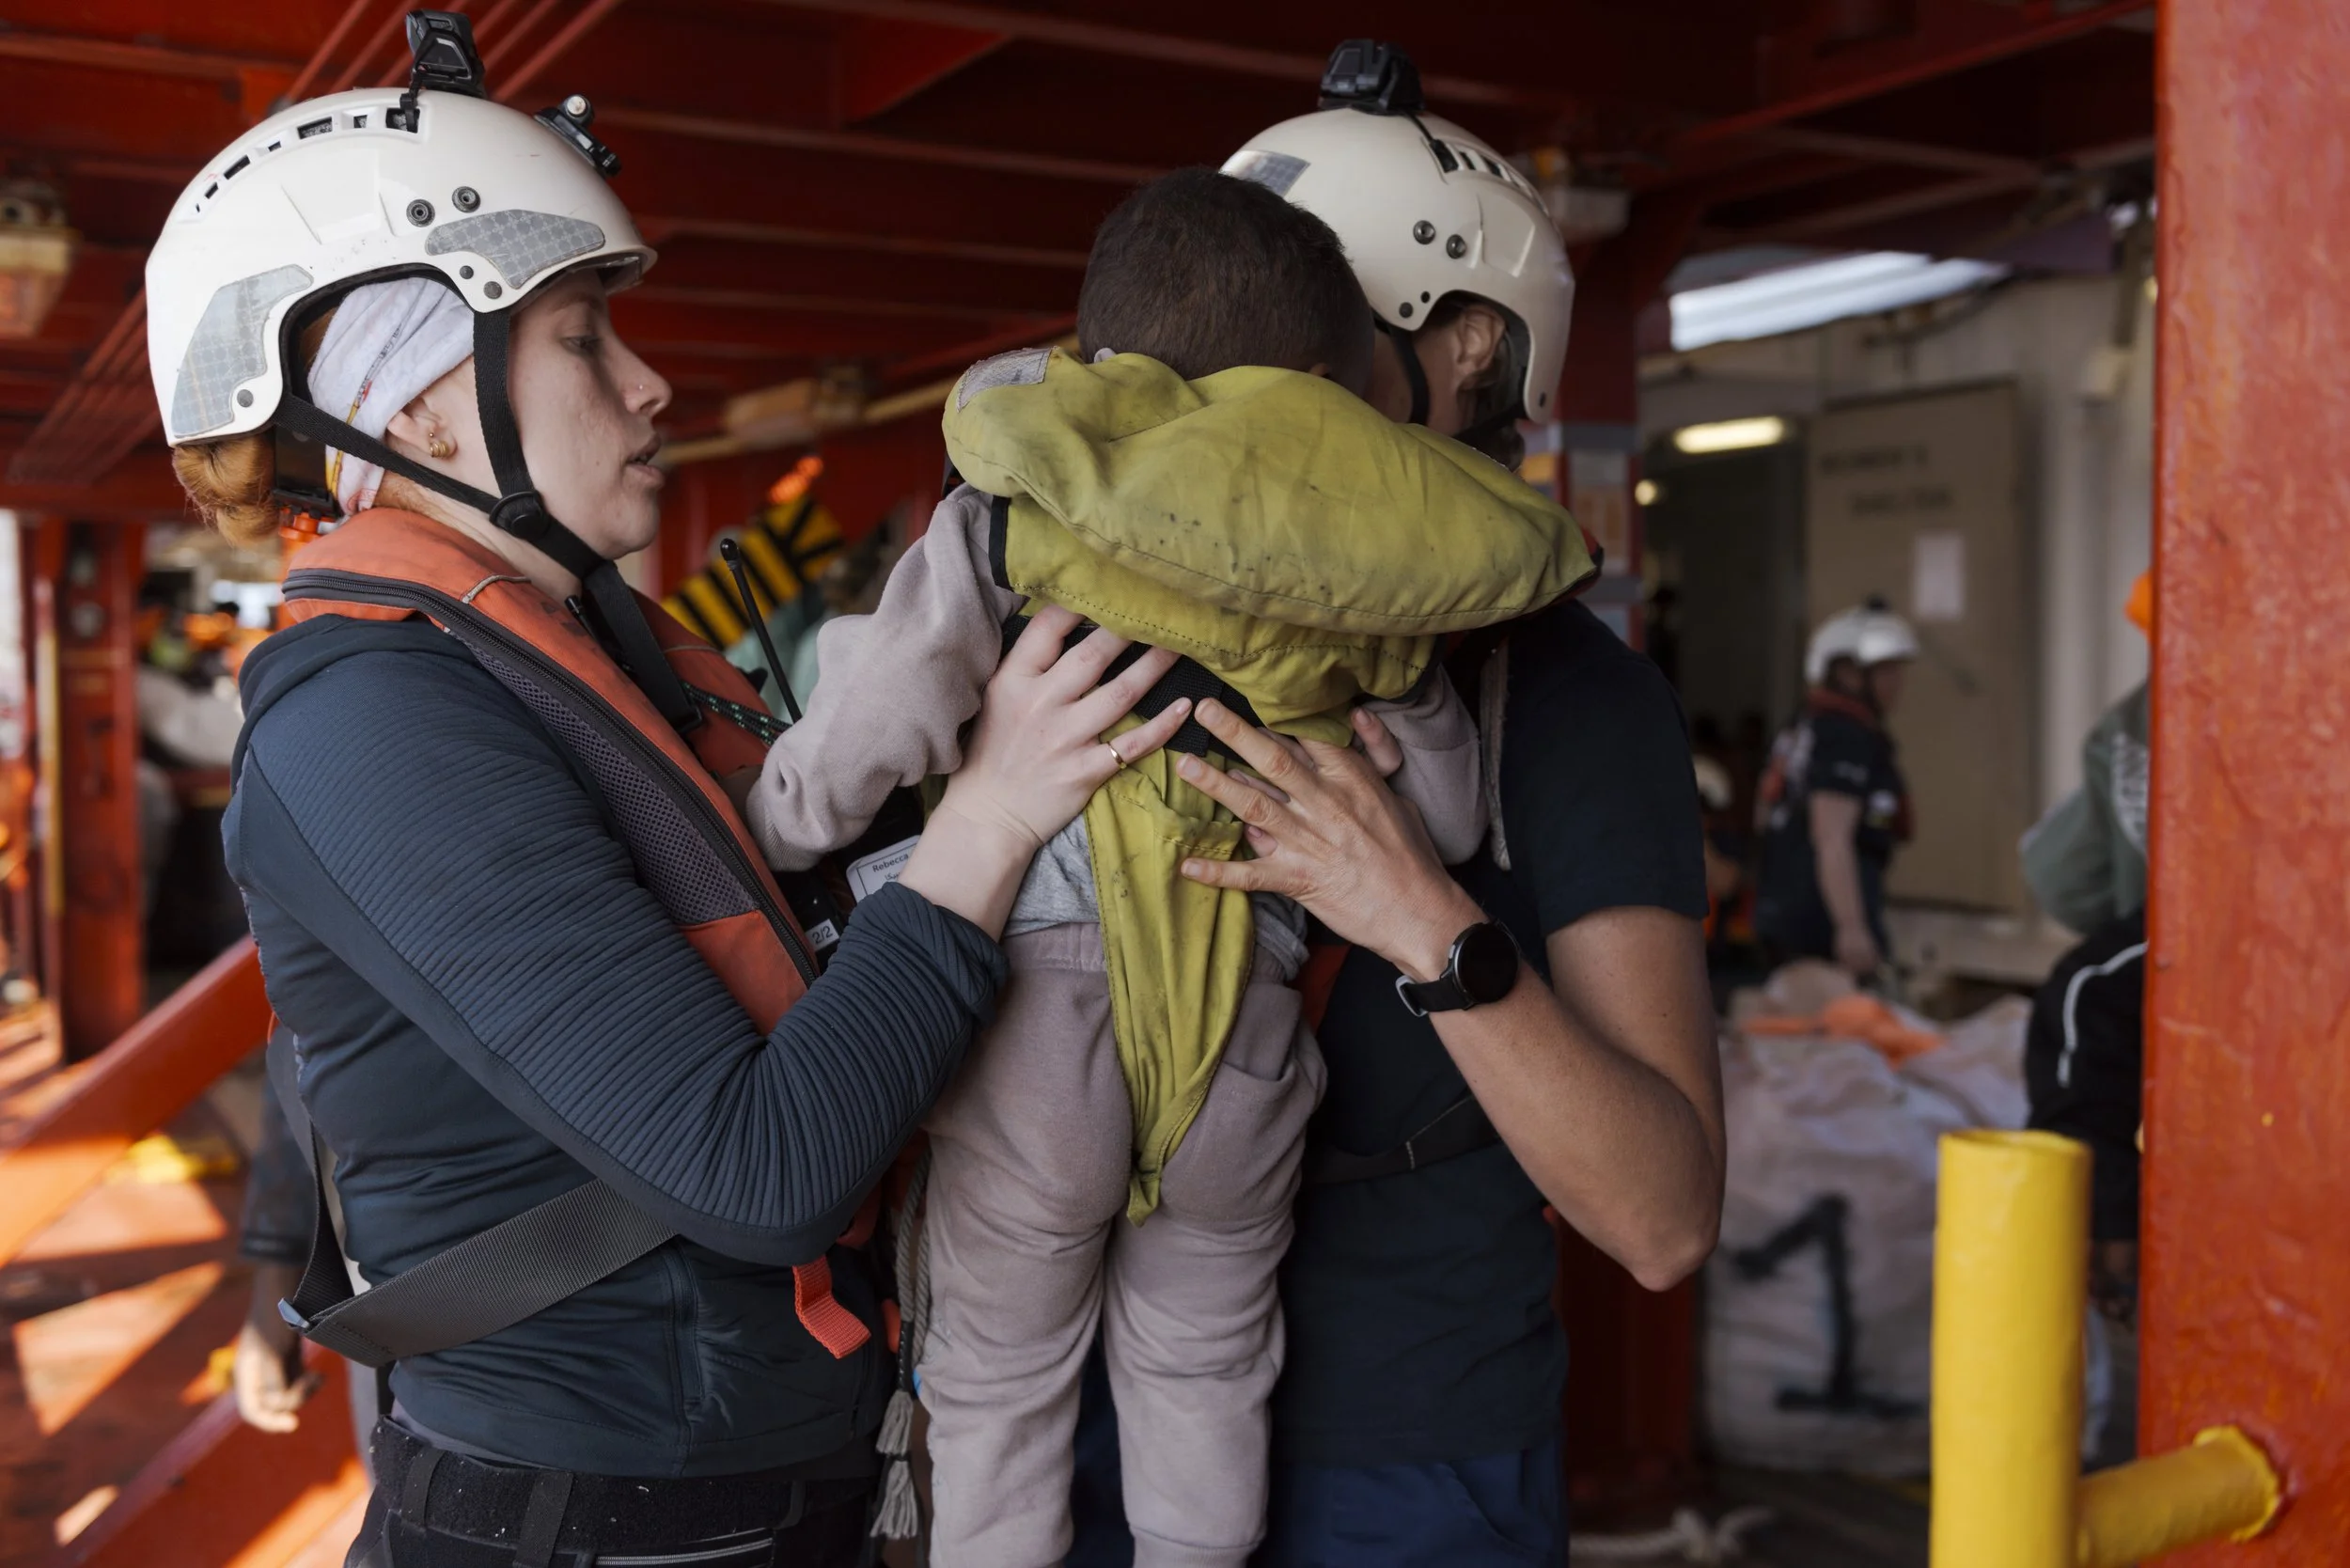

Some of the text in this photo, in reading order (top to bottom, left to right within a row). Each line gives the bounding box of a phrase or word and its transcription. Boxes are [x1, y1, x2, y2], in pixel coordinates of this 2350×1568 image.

[872, 853, 909, 872] Rebecca
[812, 925, 833, 945] 2/2
[1731, 1191, 1927, 1418] 1
